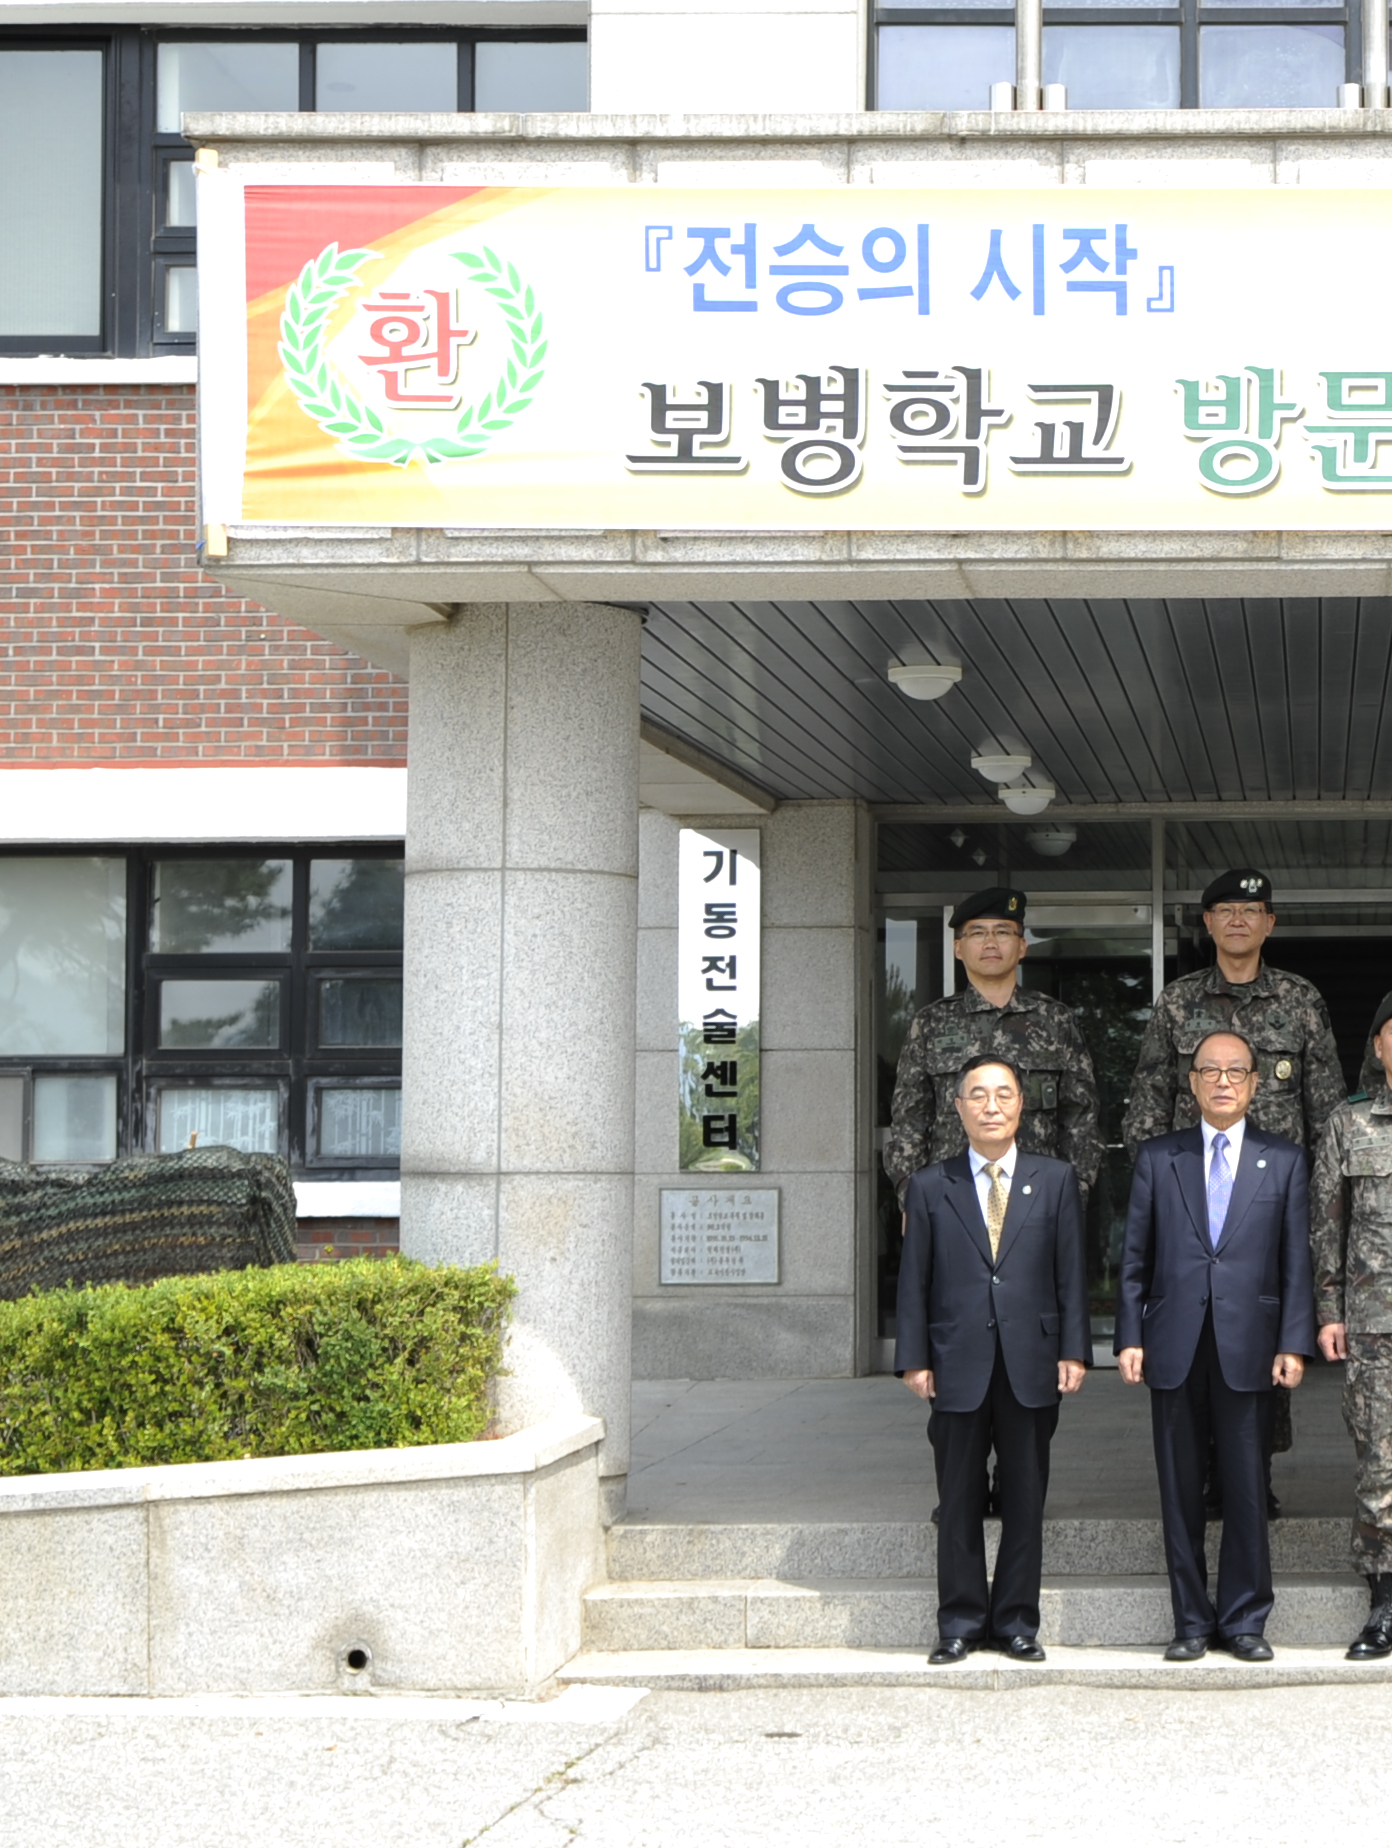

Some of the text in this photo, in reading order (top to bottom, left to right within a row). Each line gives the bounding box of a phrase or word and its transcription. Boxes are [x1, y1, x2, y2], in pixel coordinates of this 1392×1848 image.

[357, 289, 470, 404] 환
[626, 365, 1125, 487] 보병학교
[701, 848, 739, 1151] 기동전술센터
